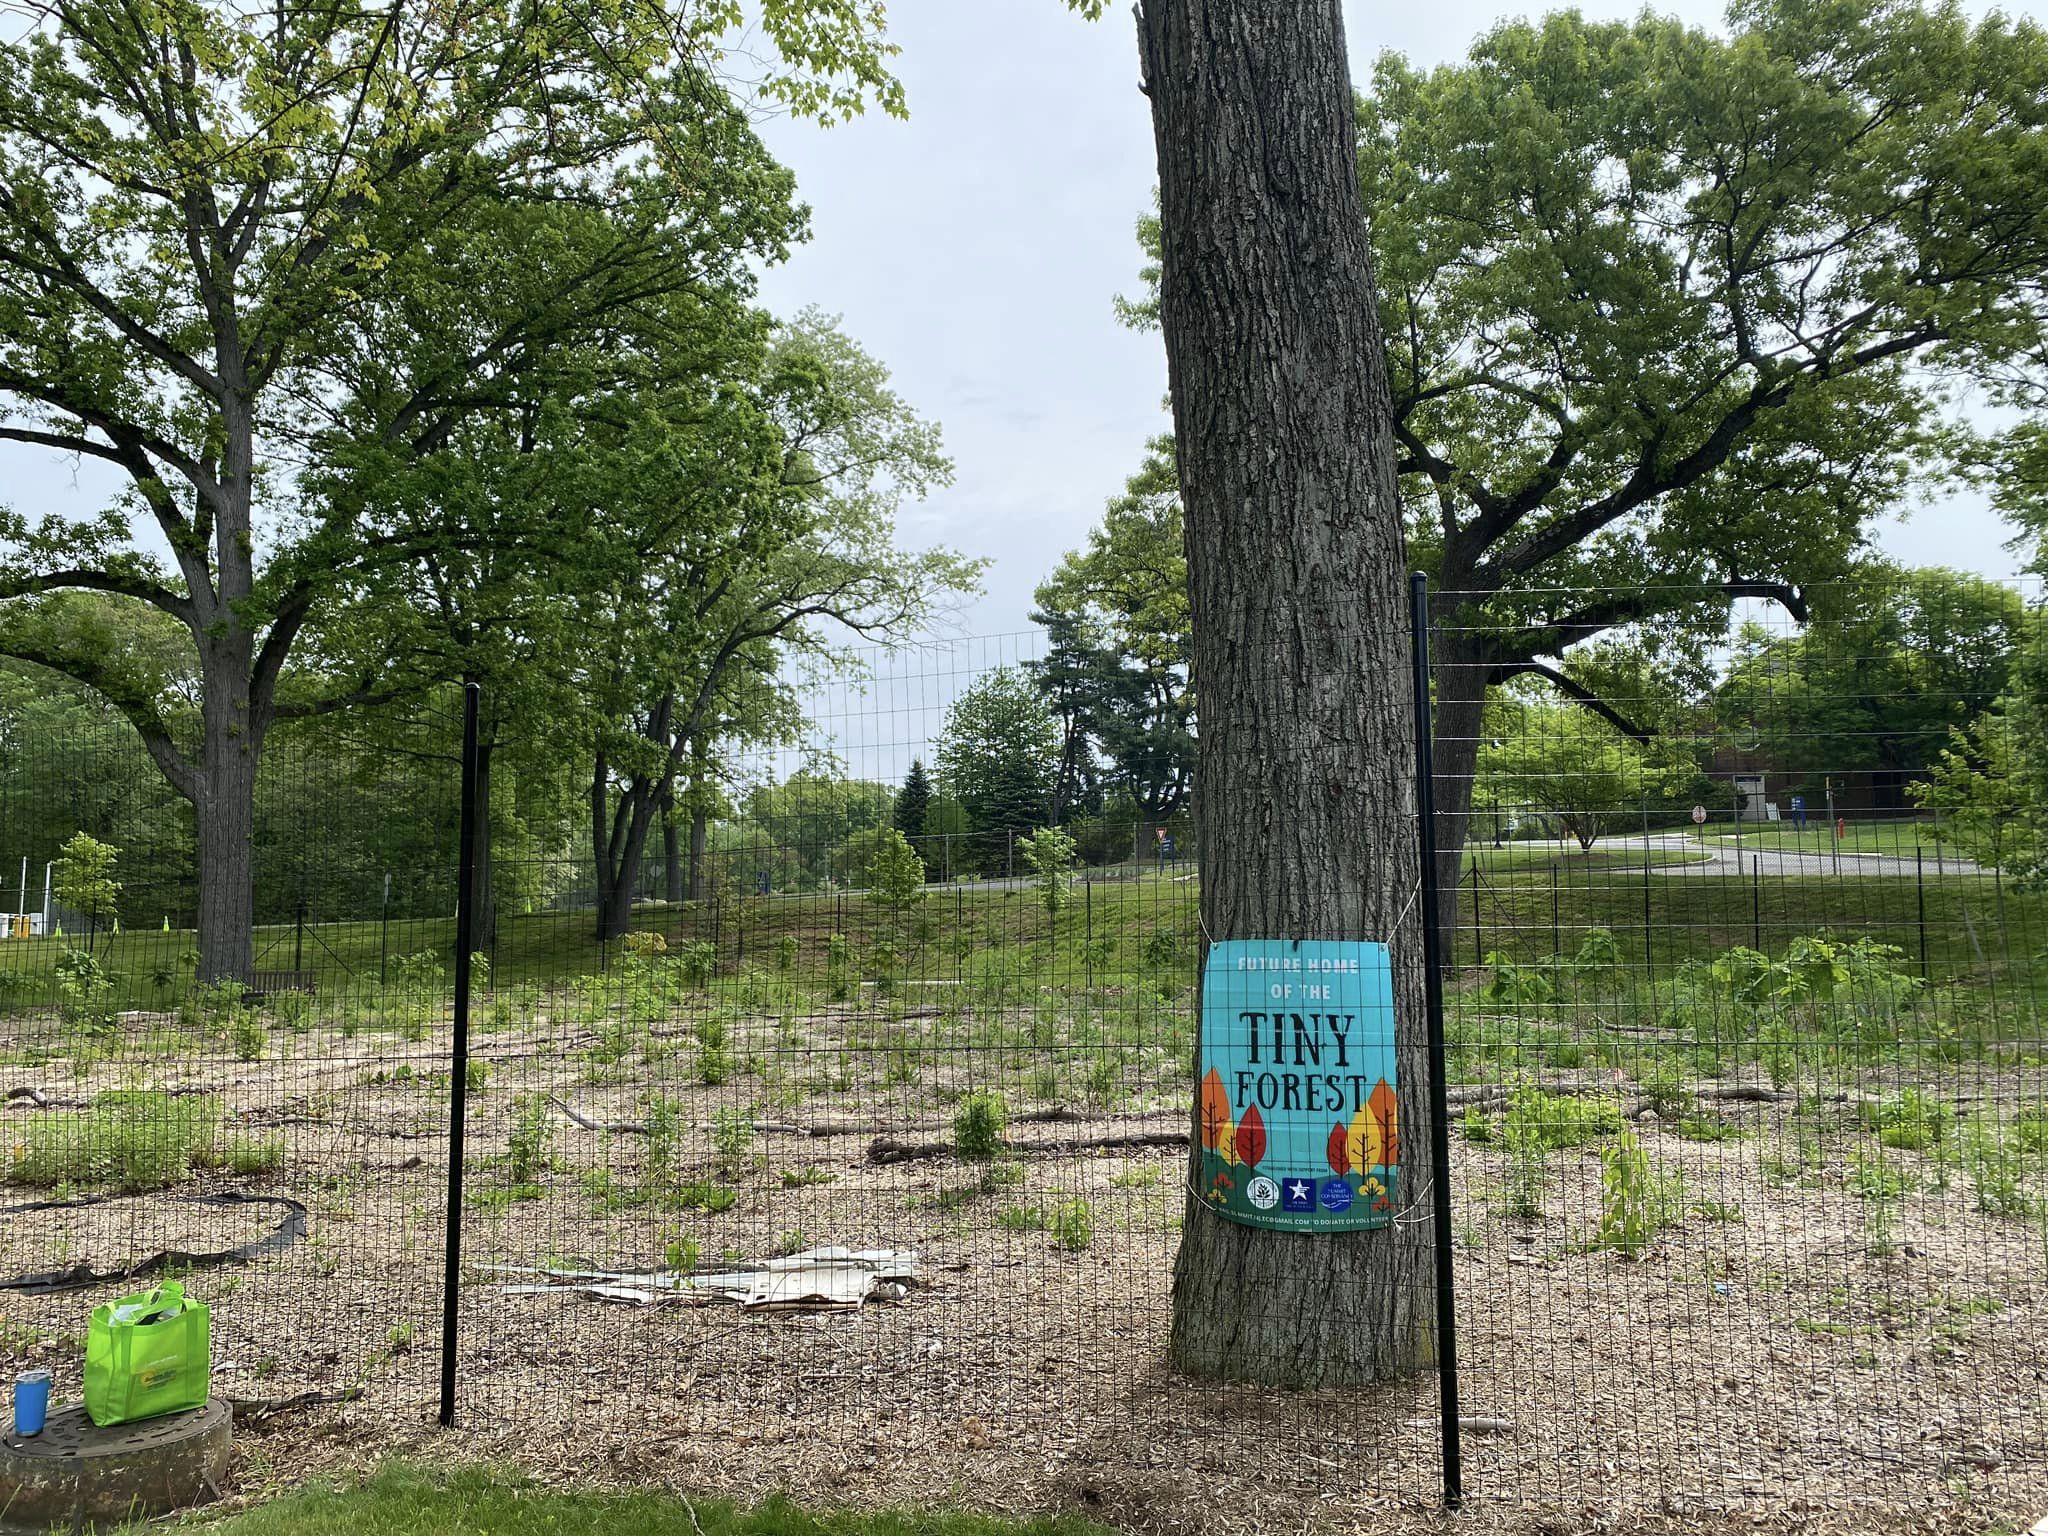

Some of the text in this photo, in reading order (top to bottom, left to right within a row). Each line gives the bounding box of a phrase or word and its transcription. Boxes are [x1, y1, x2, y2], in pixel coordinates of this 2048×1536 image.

[1238, 957, 1359, 974] FUTURE HOME
[1270, 983, 1331, 1000] OF THE
[1239, 1012, 1355, 1067] TINY
[1234, 1071, 1367, 1112] FOREST
